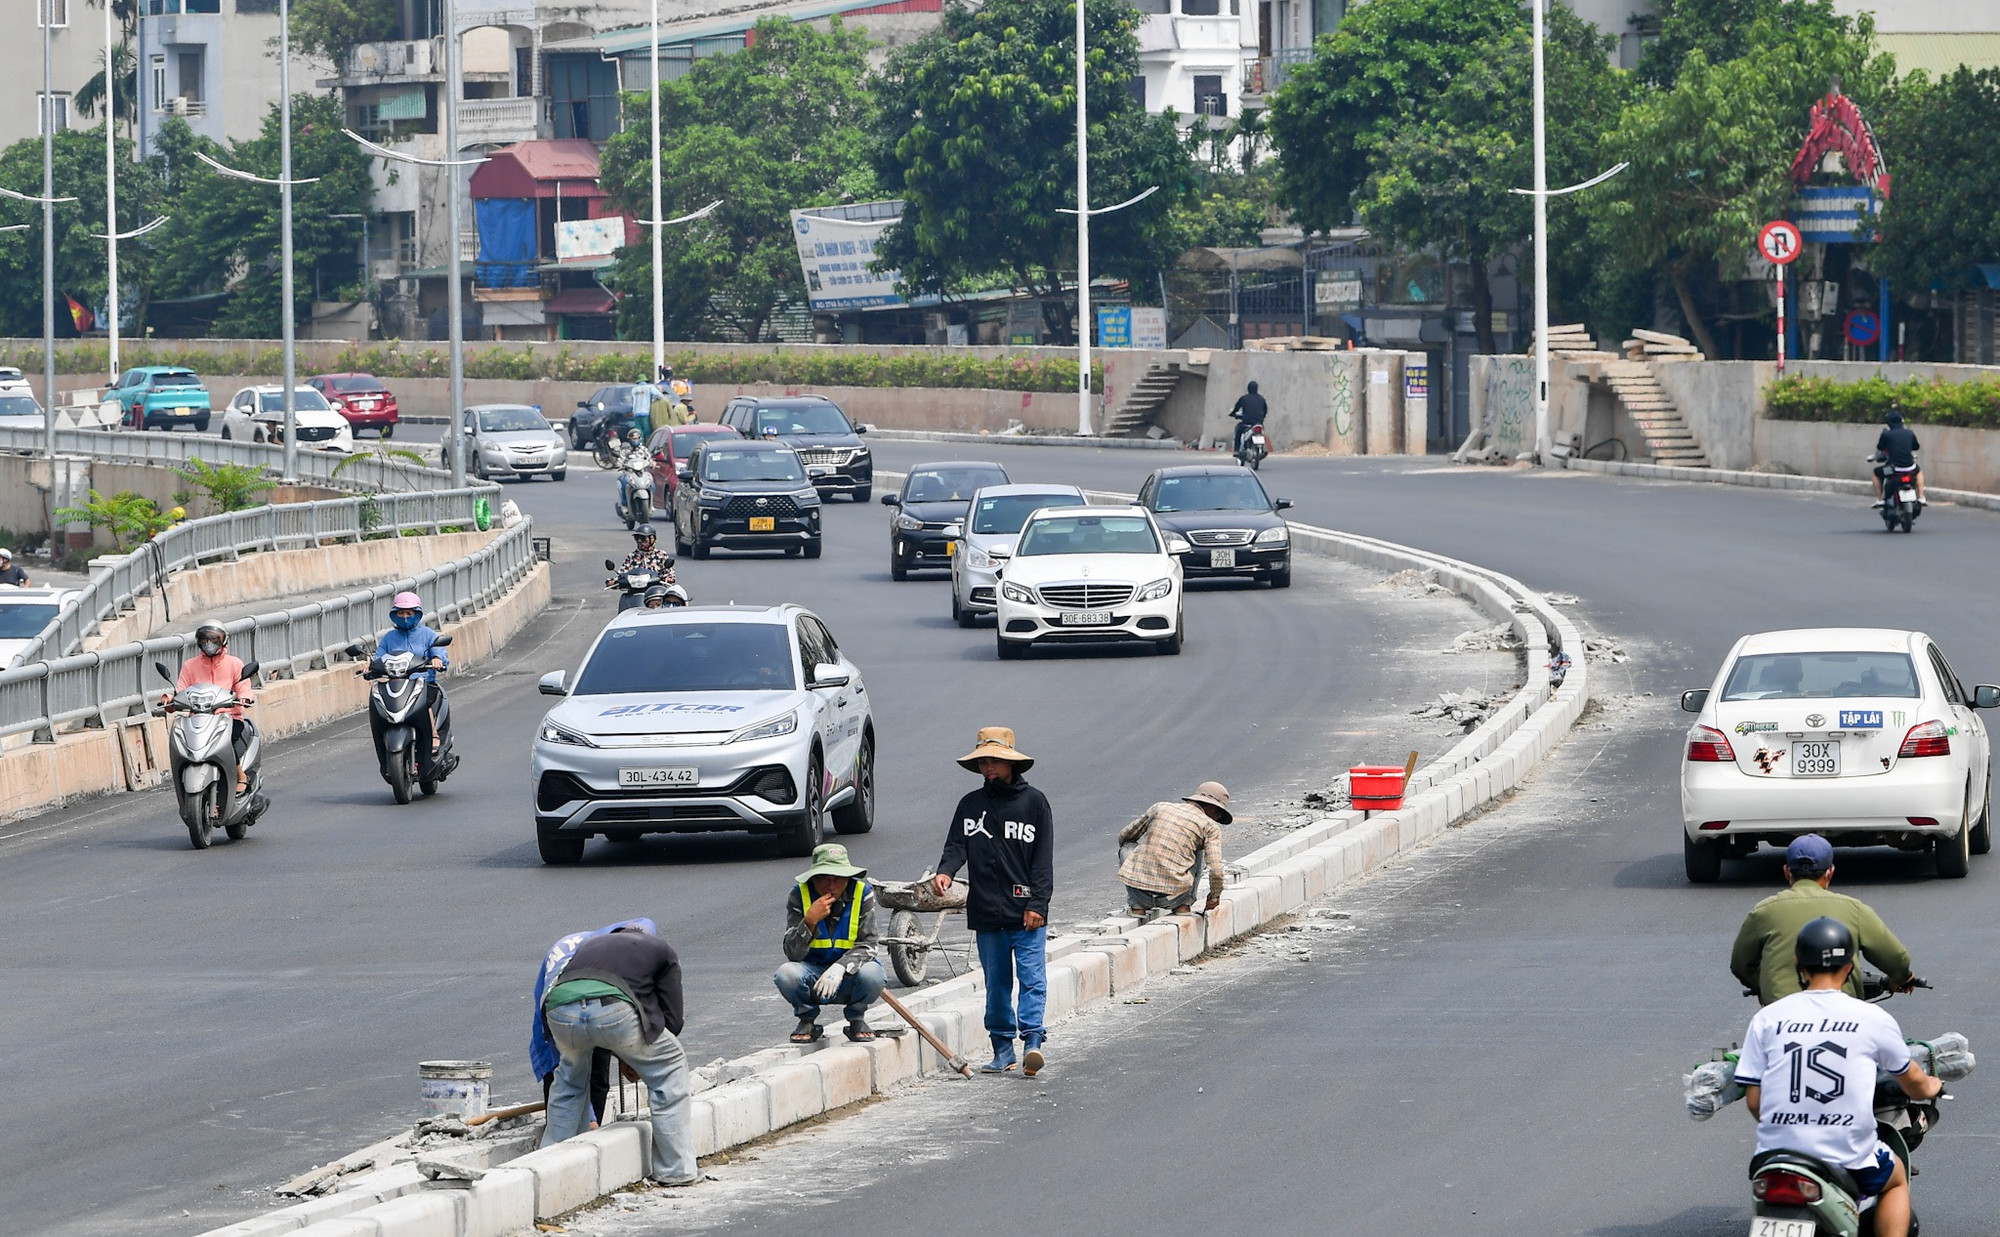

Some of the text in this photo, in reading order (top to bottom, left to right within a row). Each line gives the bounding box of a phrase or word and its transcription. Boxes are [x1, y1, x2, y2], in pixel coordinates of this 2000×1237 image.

[1216, 550, 1231, 558] 30H
[1214, 558, 1232, 567] 7713
[1063, 613, 1109, 624] 30E-683.38
[1841, 711, 1882, 726] TẬP LÁI
[1802, 743, 1830, 758] 30X
[1797, 759, 1836, 774] 9399
[625, 769, 692, 783] 30L-434.42
[1776, 1018, 1859, 1035] Van Luu
[1770, 1112, 1854, 1126] HRM-K22
[1760, 1220, 1803, 1237] 21-C1
